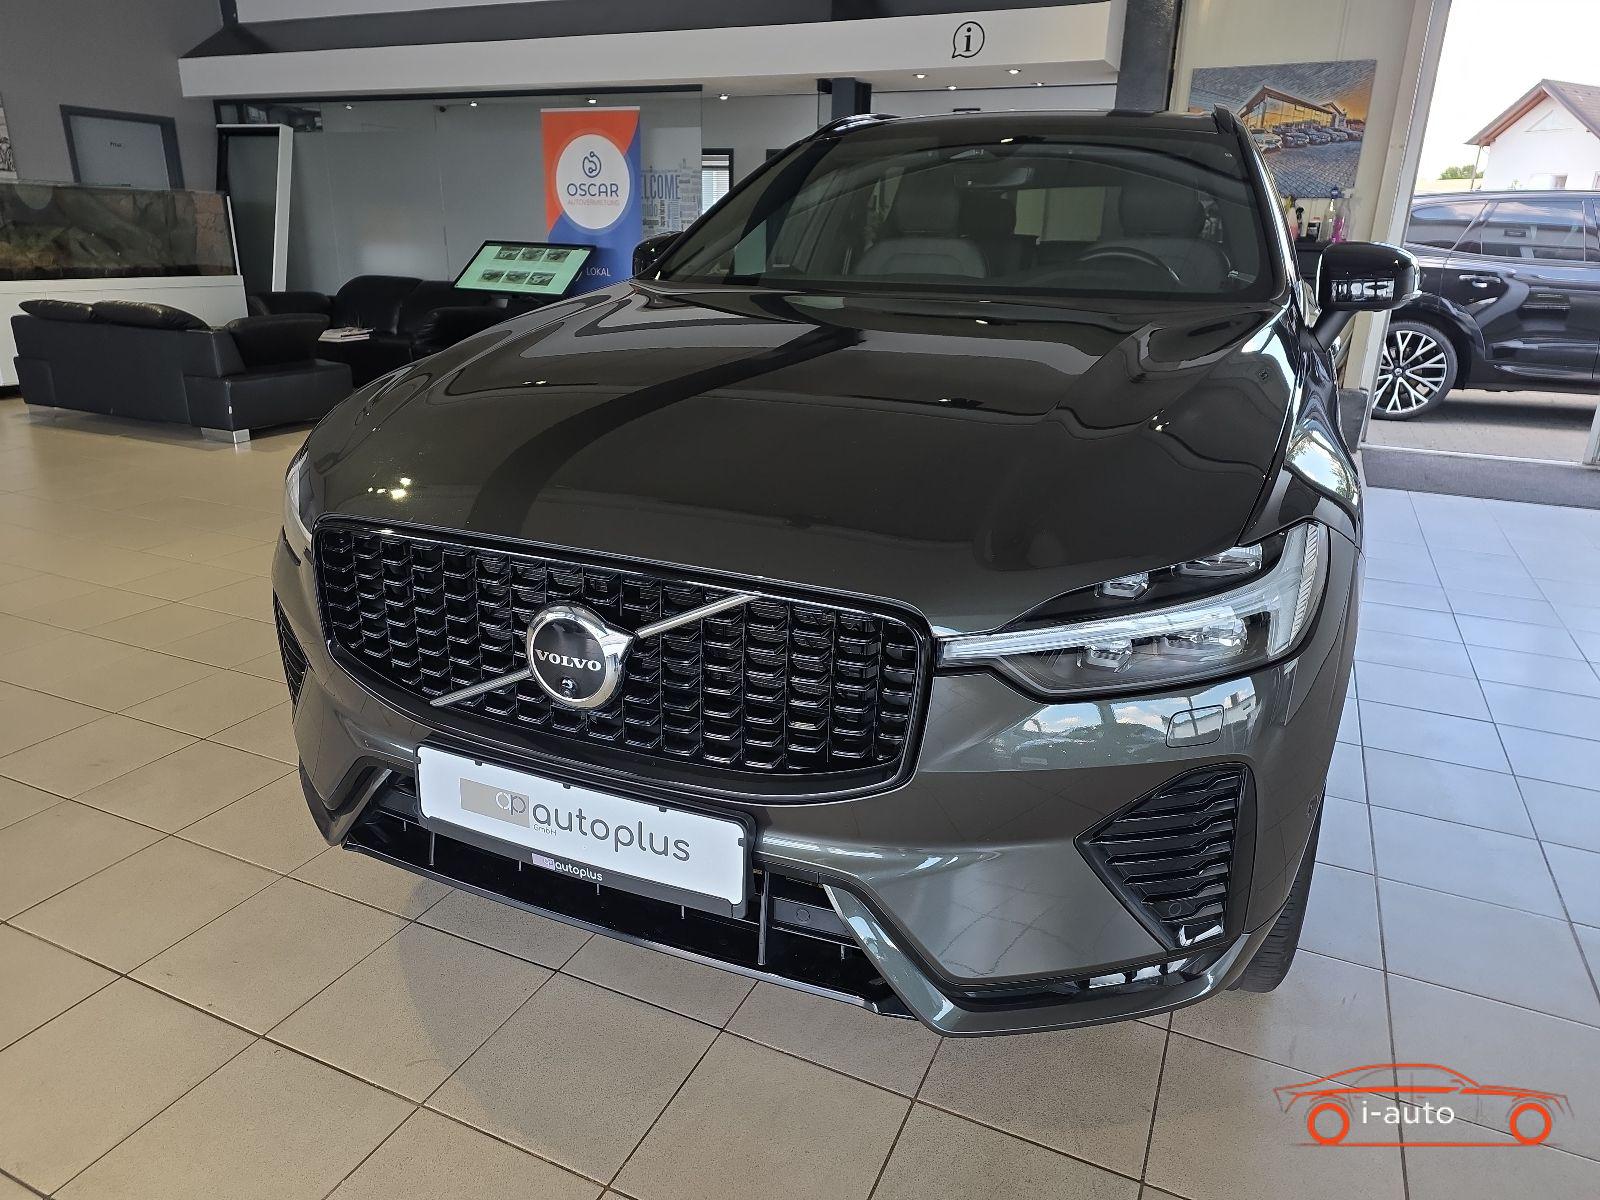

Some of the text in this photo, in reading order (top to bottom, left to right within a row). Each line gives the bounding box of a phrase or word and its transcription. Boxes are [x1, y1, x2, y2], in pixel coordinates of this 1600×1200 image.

[567, 183, 619, 197] OSCAR
[586, 267, 611, 277] LOKAL
[533, 648, 602, 672] VOLVO
[532, 803, 690, 862] autoplus
[533, 823, 557, 836] GmbH
[555, 861, 603, 881] autoplus
